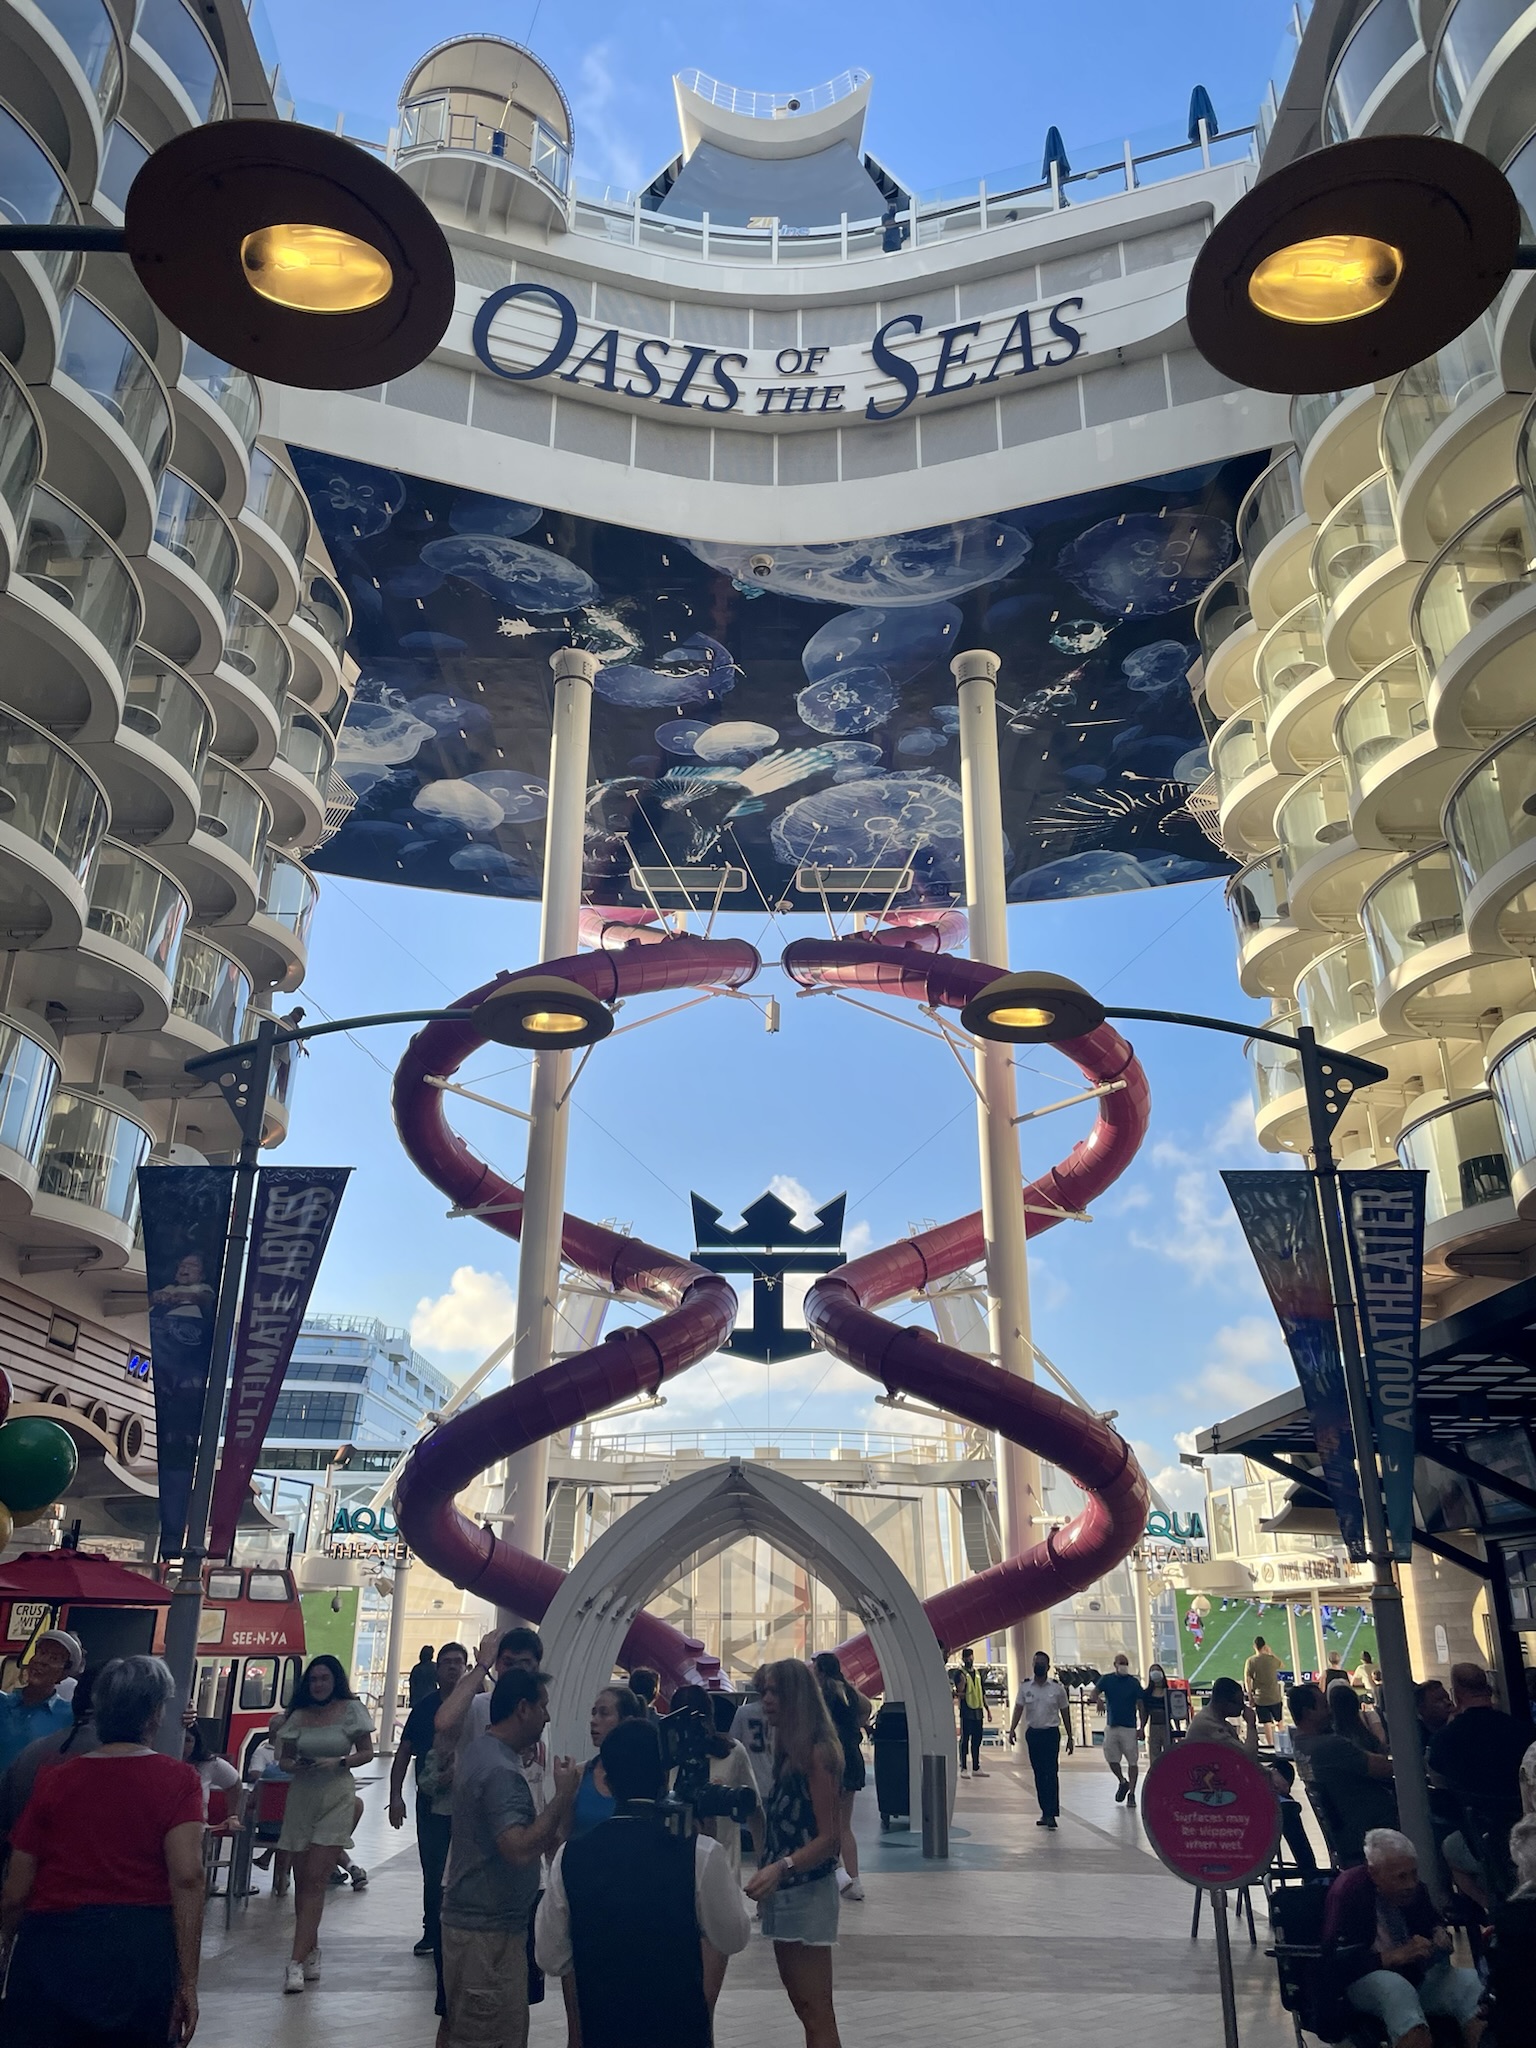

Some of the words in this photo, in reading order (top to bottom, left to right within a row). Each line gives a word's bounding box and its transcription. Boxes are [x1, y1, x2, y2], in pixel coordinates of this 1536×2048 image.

[747, 216, 780, 229] ZI
[472, 283, 748, 412] OASIS
[775, 347, 830, 375] OF
[864, 296, 1084, 421] SEAS
[757, 385, 846, 415] THE
[257, 1185, 335, 1281] ABYSS
[1351, 1188, 1414, 1433] AQUATHEATER
[234, 1287, 298, 1440] ULTIMATE
[332, 1507, 399, 1541] AQU
[1146, 1510, 1205, 1544] QUA
[16, 1604, 48, 1616] CRUS
[20, 1616, 41, 1627] WIT
[231, 1631, 287, 1645] SEE-N-YA
[1174, 1811, 1224, 1823] Surfaces
[1226, 1814, 1250, 1826] may
[1181, 1825, 1195, 1836] be
[1199, 1825, 1246, 1839] slippery
[1185, 1839, 1218, 1850] when
